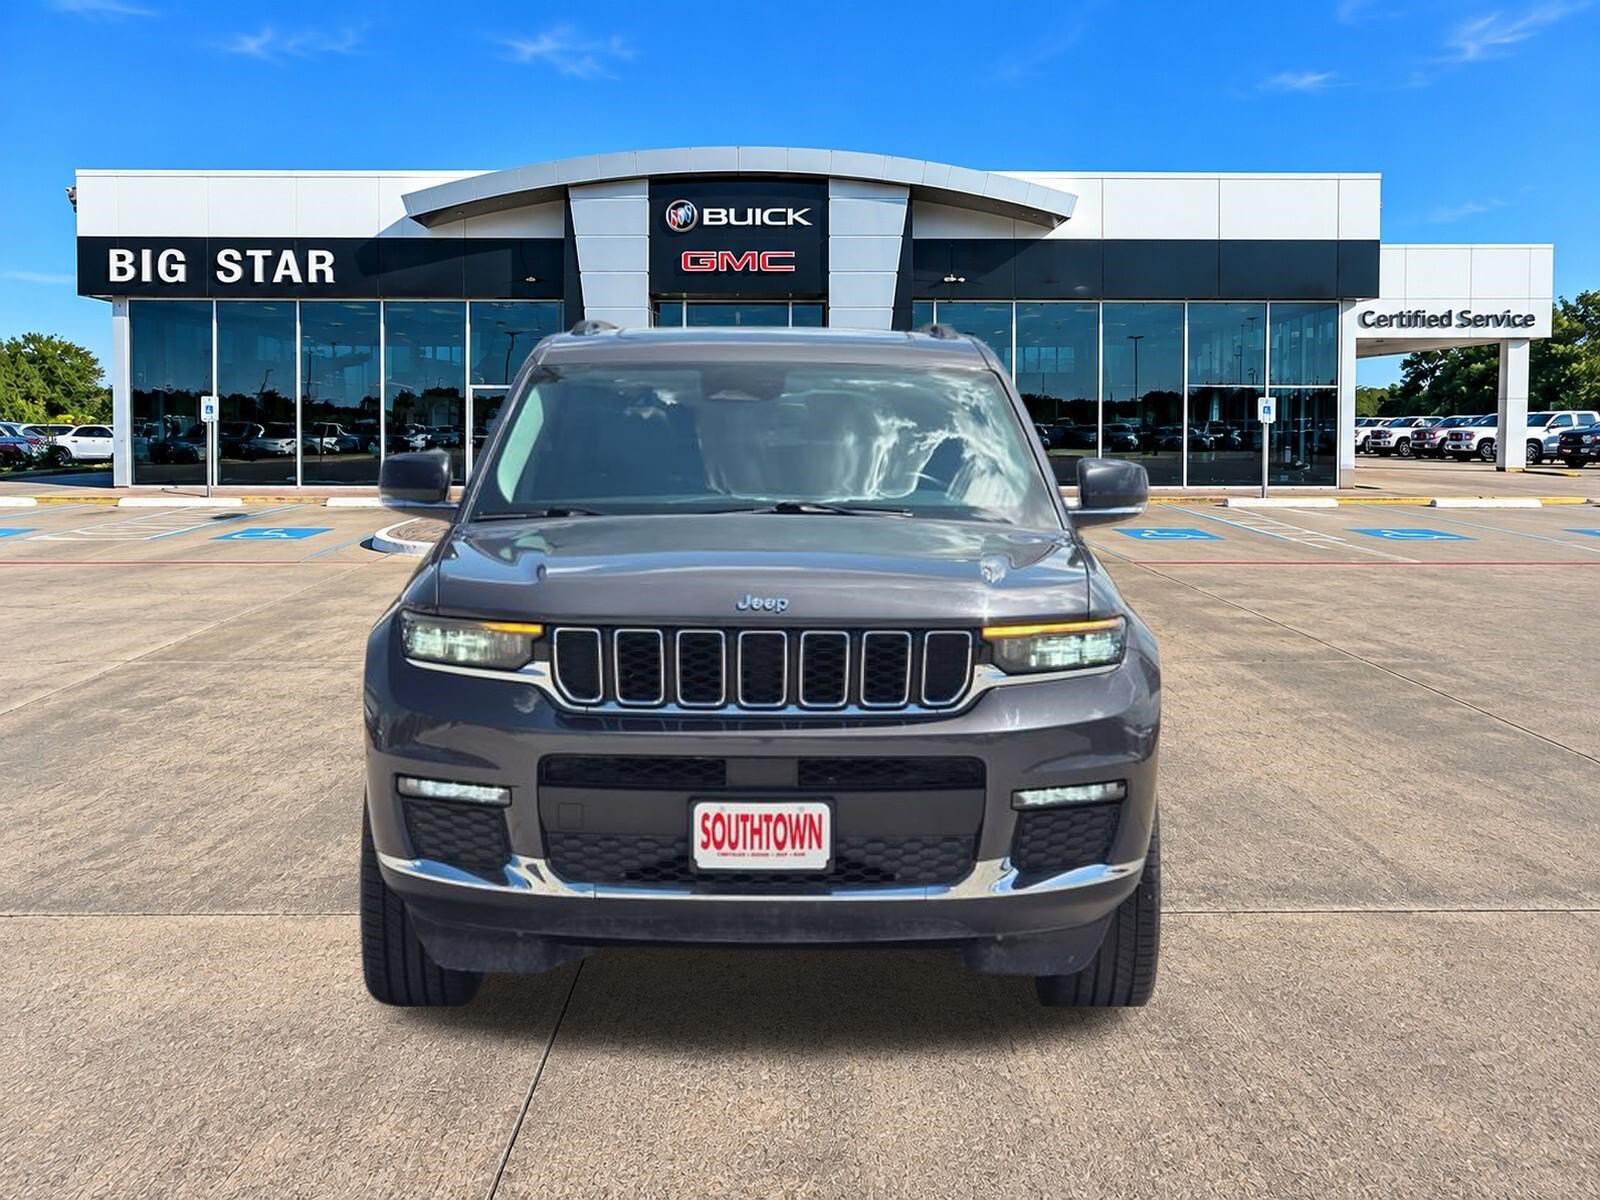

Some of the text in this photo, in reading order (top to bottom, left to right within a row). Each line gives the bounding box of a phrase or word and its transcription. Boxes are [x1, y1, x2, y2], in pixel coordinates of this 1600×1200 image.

[703, 208, 813, 226] BUICK
[109, 249, 336, 283] BIG STAR
[681, 251, 796, 272] GMC
[1359, 309, 1536, 328] Certified Service
[737, 594, 789, 613] Jeep
[700, 812, 823, 850] SOUTHTOWN
